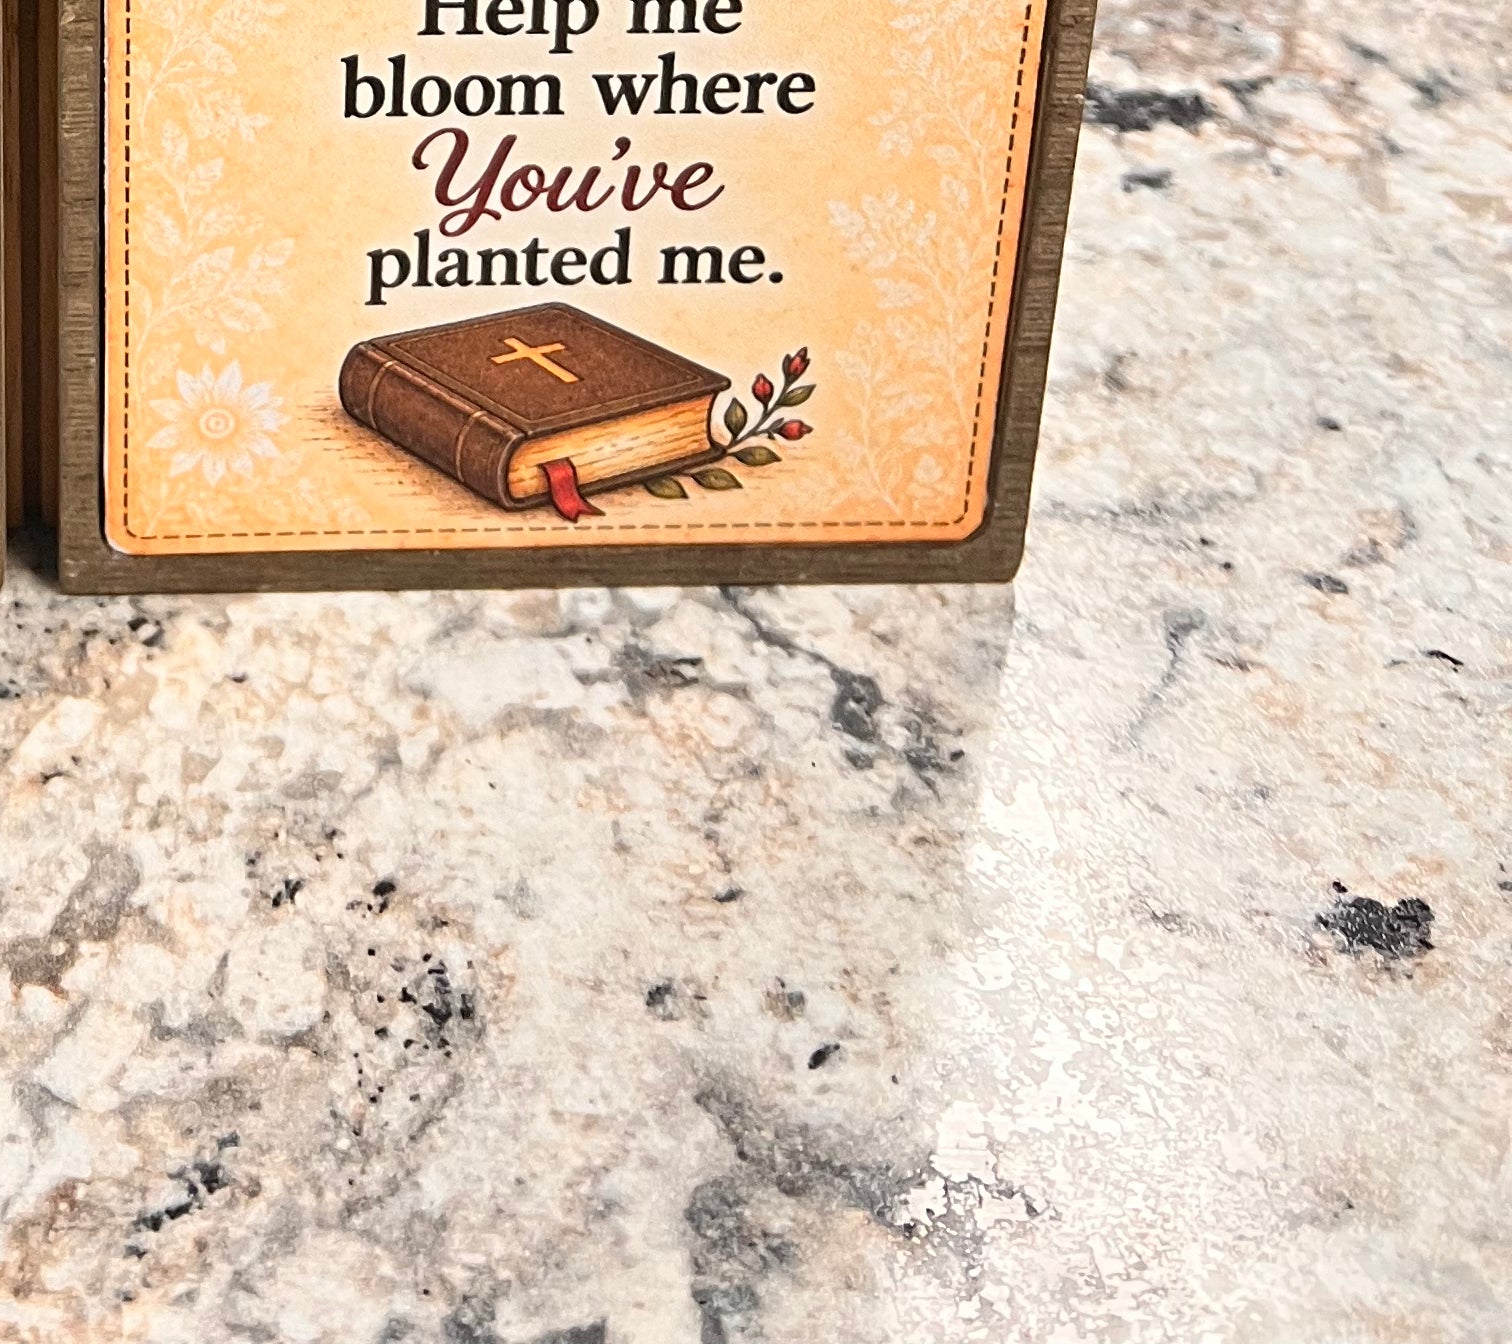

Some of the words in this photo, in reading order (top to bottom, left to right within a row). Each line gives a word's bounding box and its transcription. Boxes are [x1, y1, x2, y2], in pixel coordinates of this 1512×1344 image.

[340, 53, 565, 120] bloom
[591, 51, 817, 116] where
[411, 126, 726, 239] You've
[363, 227, 633, 307] planted
[657, 243, 785, 285] me.
